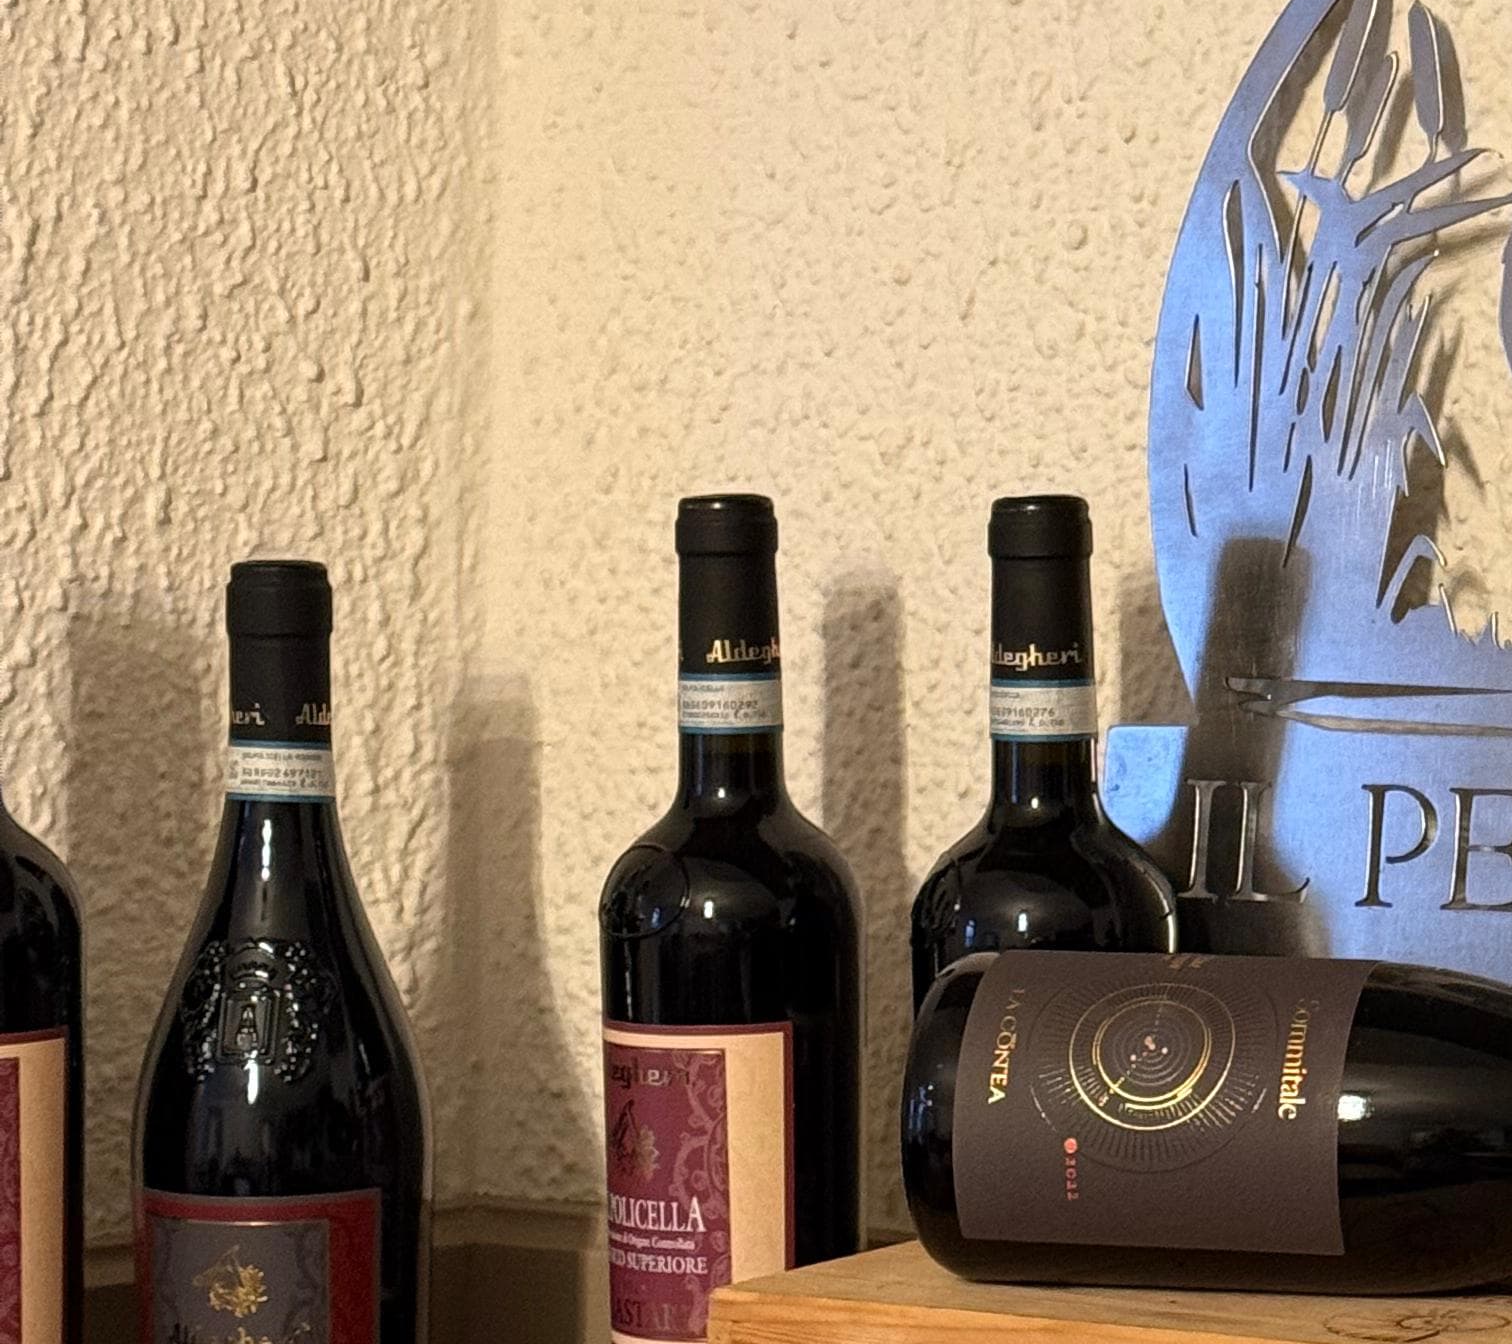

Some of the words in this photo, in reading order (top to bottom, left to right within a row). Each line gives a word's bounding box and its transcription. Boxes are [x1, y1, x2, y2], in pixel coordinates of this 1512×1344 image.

[705, 636, 779, 664] Aldegh
[1180, 778, 1309, 904] IL
[1278, 998, 1320, 1120] Sommitale
[610, 1195, 707, 1232] OLICELLA
[627, 1252, 708, 1275] SUPERIORE
